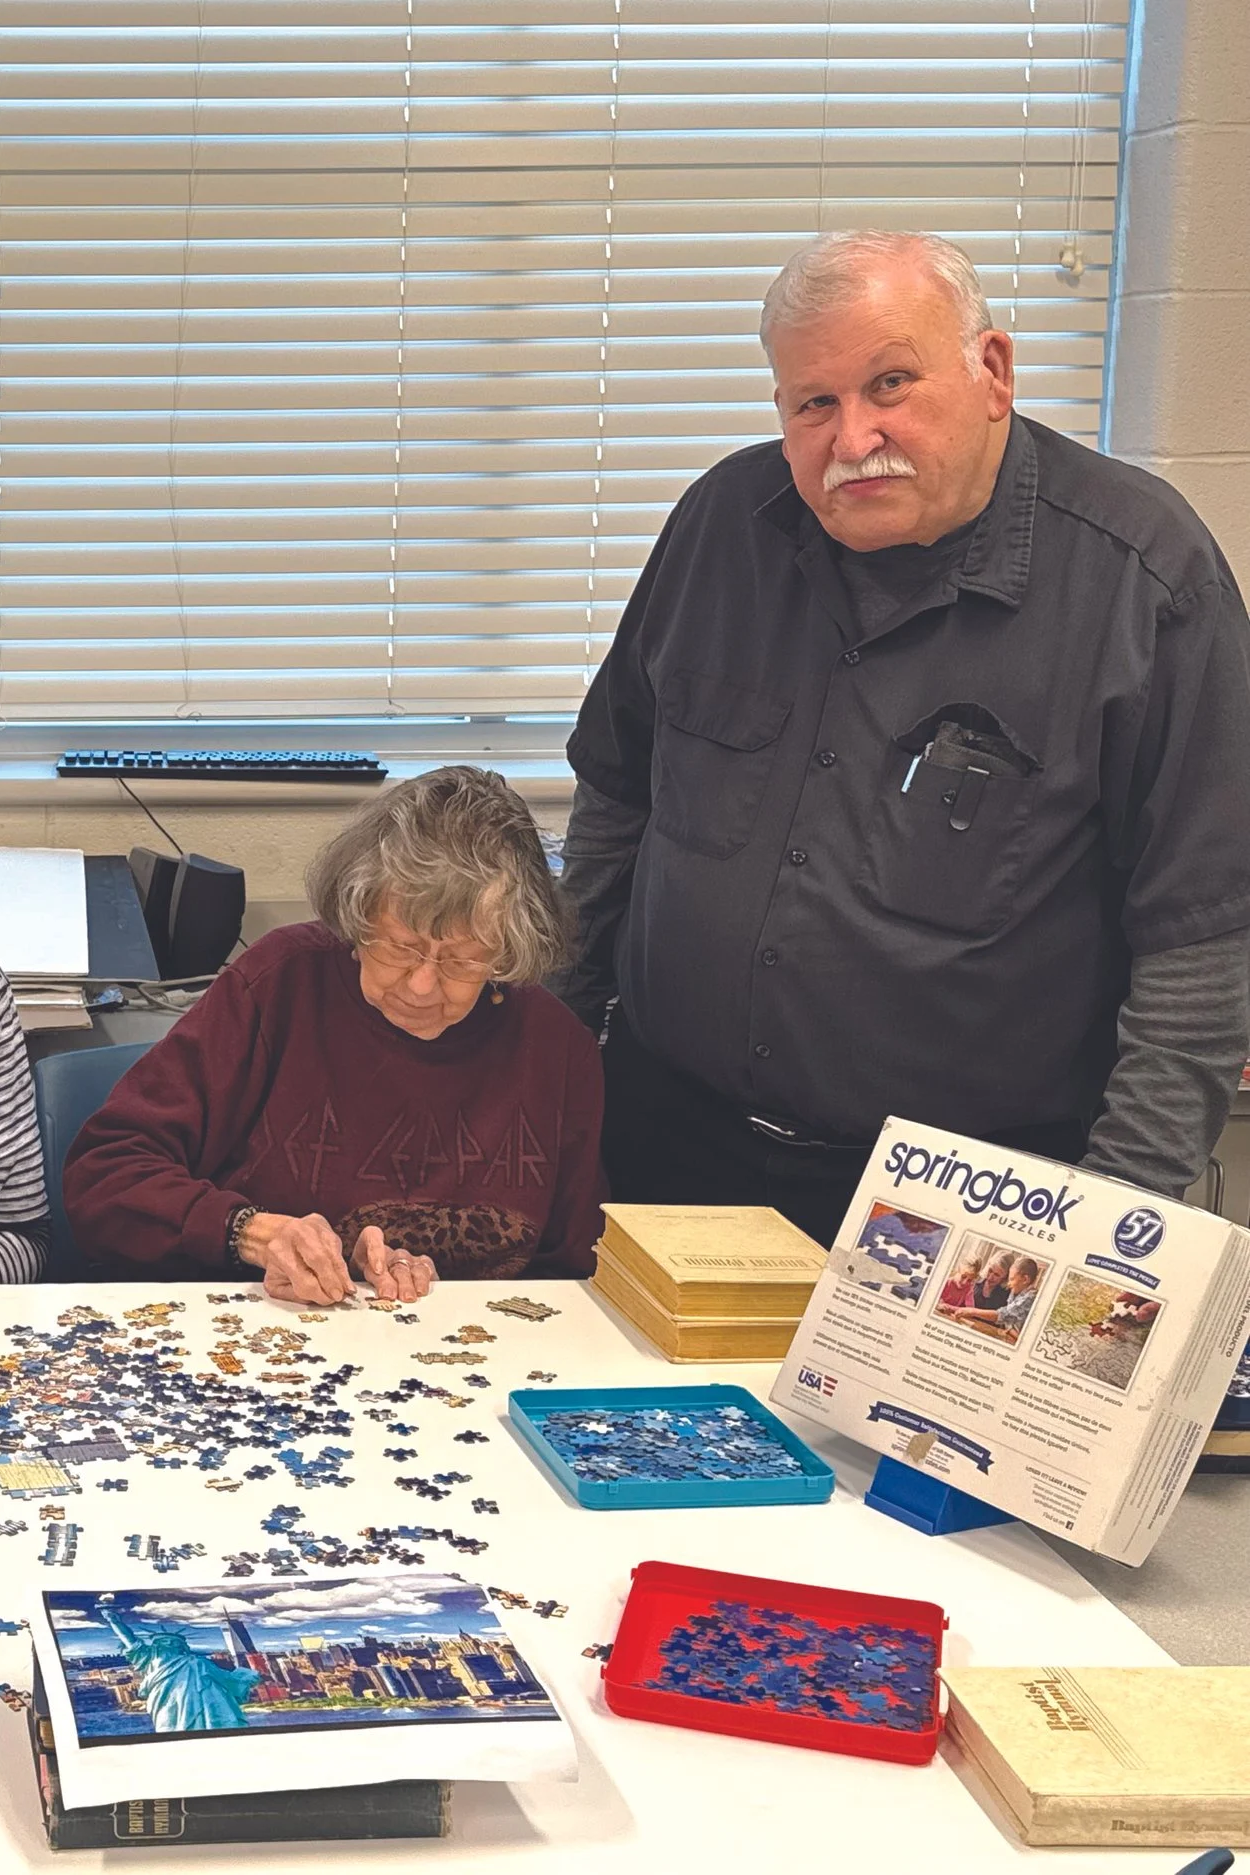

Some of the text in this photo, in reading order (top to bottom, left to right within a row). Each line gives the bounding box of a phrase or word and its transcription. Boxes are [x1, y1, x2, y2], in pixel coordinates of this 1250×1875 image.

[356, 1101, 563, 1190] LEPPAR
[885, 1141, 1080, 1231] springbok
[989, 1212, 1056, 1242] PUZZLES
[1117, 1210, 1163, 1248] 57
[798, 1368, 823, 1392] USA
[1018, 1680, 1070, 1731] Baptist
[128, 1800, 144, 1834] BAPTIS
[153, 1799, 170, 1834] HYMNA
[1110, 1820, 1175, 1834] Baptist
